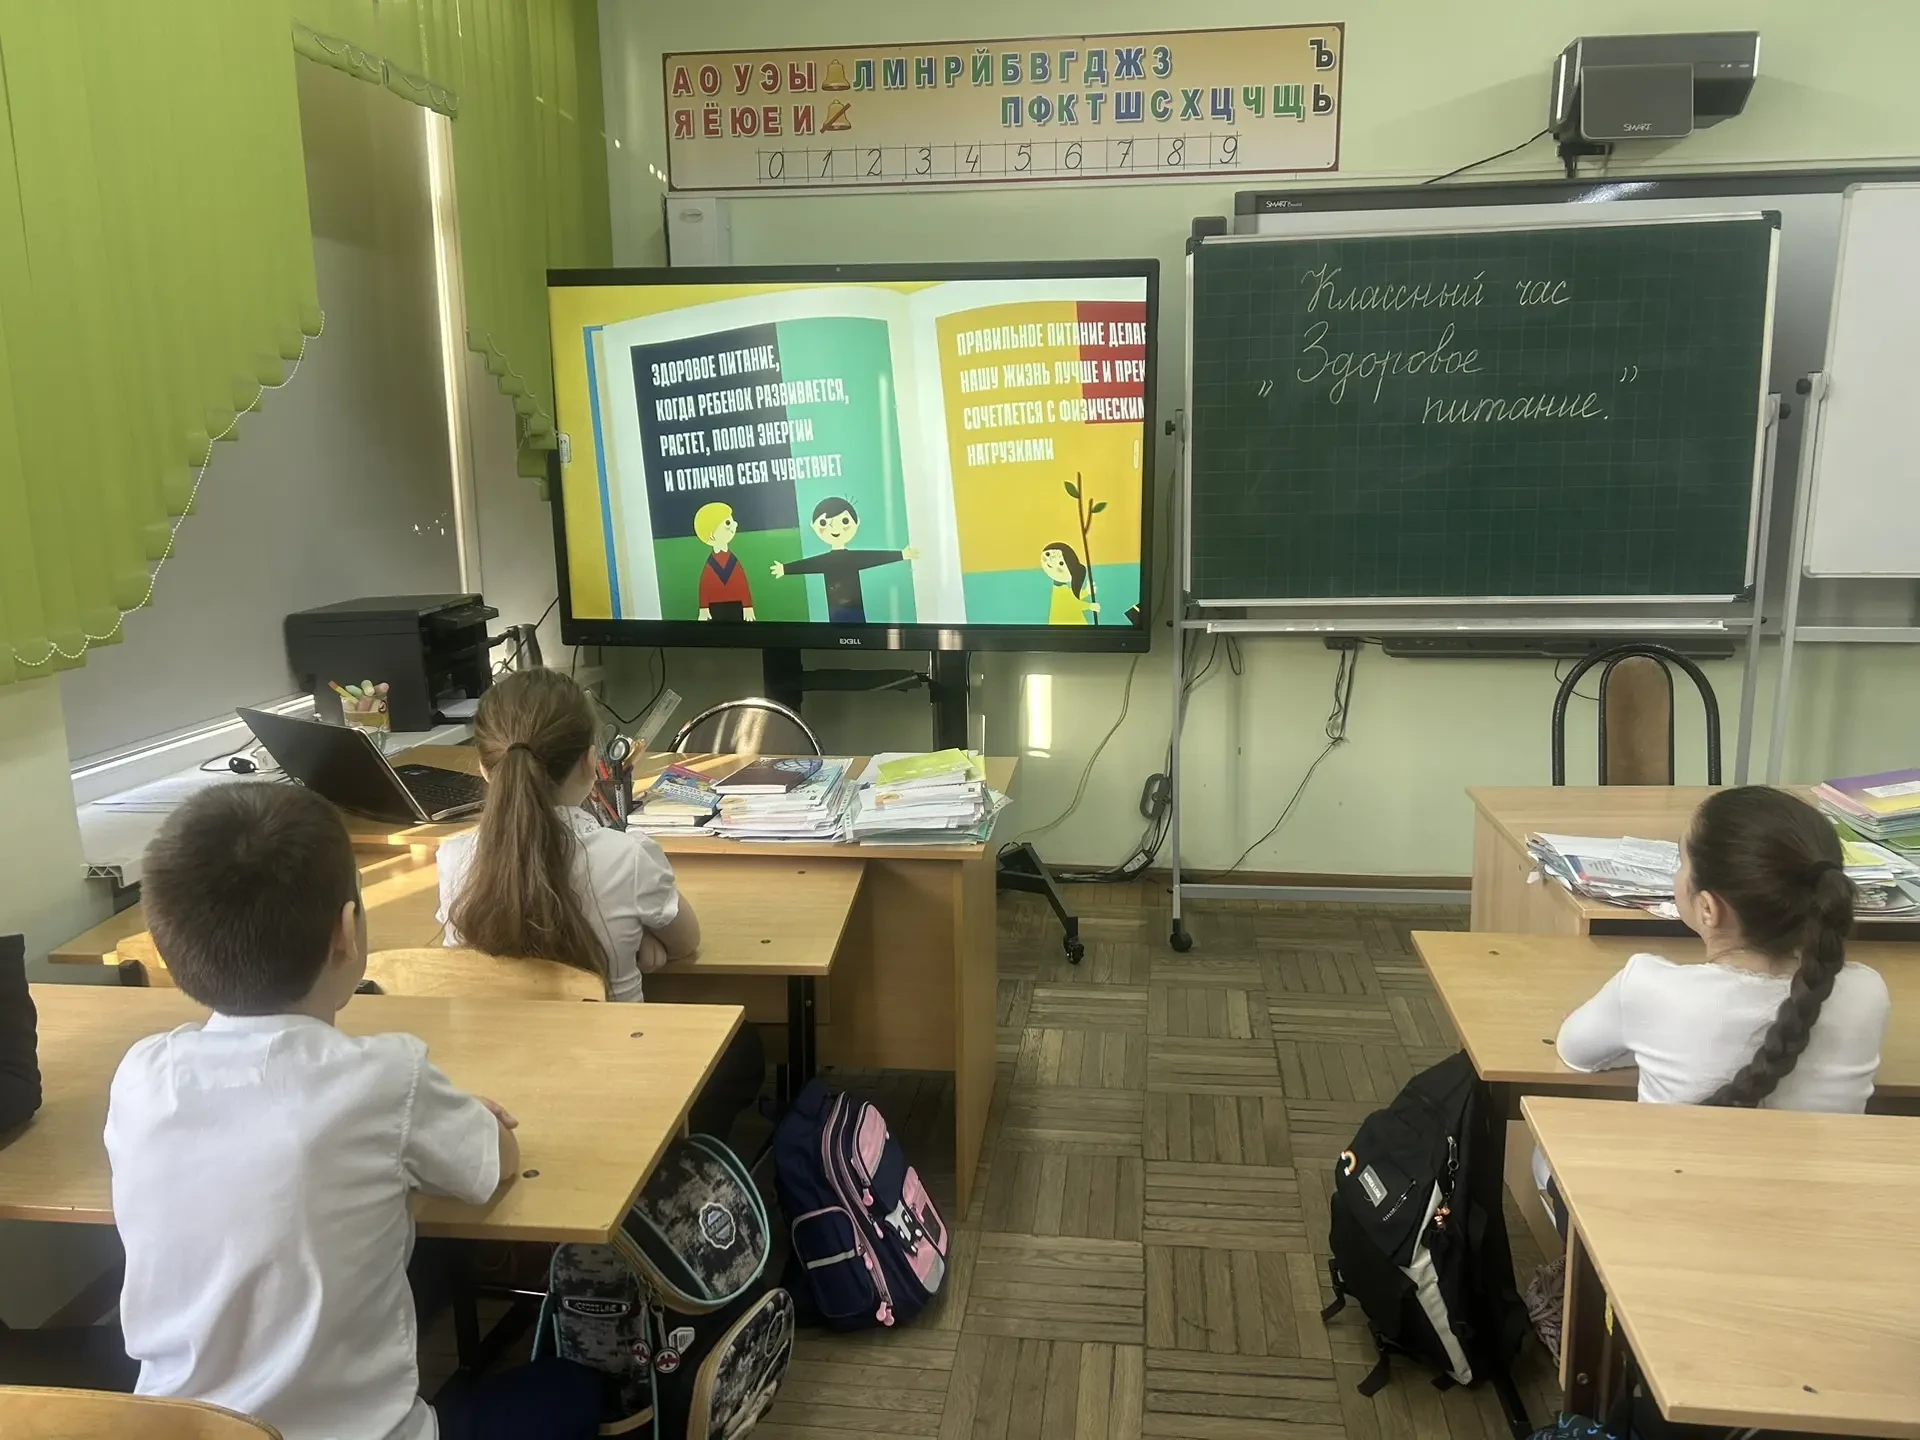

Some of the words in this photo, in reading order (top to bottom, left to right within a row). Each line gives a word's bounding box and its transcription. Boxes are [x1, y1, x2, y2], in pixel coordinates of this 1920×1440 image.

[1623, 123, 1652, 131] SMART
[1300, 263, 1486, 313] Классный
[1515, 279, 1571, 306] час
[956, 323, 1044, 357] ПРАВИЛЬНОЕ
[1047, 322, 1106, 348] ПИТАНИЕ
[651, 354, 717, 388] ЗДОРОВОЕ
[718, 344, 780, 377] ПИТАНИЕ,
[960, 366, 999, 393] НАШУ
[1002, 362, 1051, 389] ЖИЗНЬ
[1054, 360, 1099, 385] ЛУЧШЕ
[1102, 359, 1112, 383] И
[1296, 320, 1485, 405] Здоровое
[655, 395, 696, 422] КОГДА
[697, 386, 754, 417] РЕБЕНОК
[755, 377, 850, 409] РАЗВИВАЕТСЯ,
[963, 400, 1044, 431] СОЧЕТАЕТСЯ
[1047, 399, 1056, 423] С
[659, 430, 711, 457] РАСТЕТ,
[712, 423, 755, 452] ПОЛОН
[758, 418, 814, 446] ЭНЕРГИИ
[966, 437, 1055, 467] НАГРУЗКАМИ
[663, 469, 674, 493] И
[676, 463, 735, 491] ОТЛИЧНО
[736, 460, 769, 485] СЕБЯ
[770, 453, 843, 481] ЧУВСТВУЕТ
